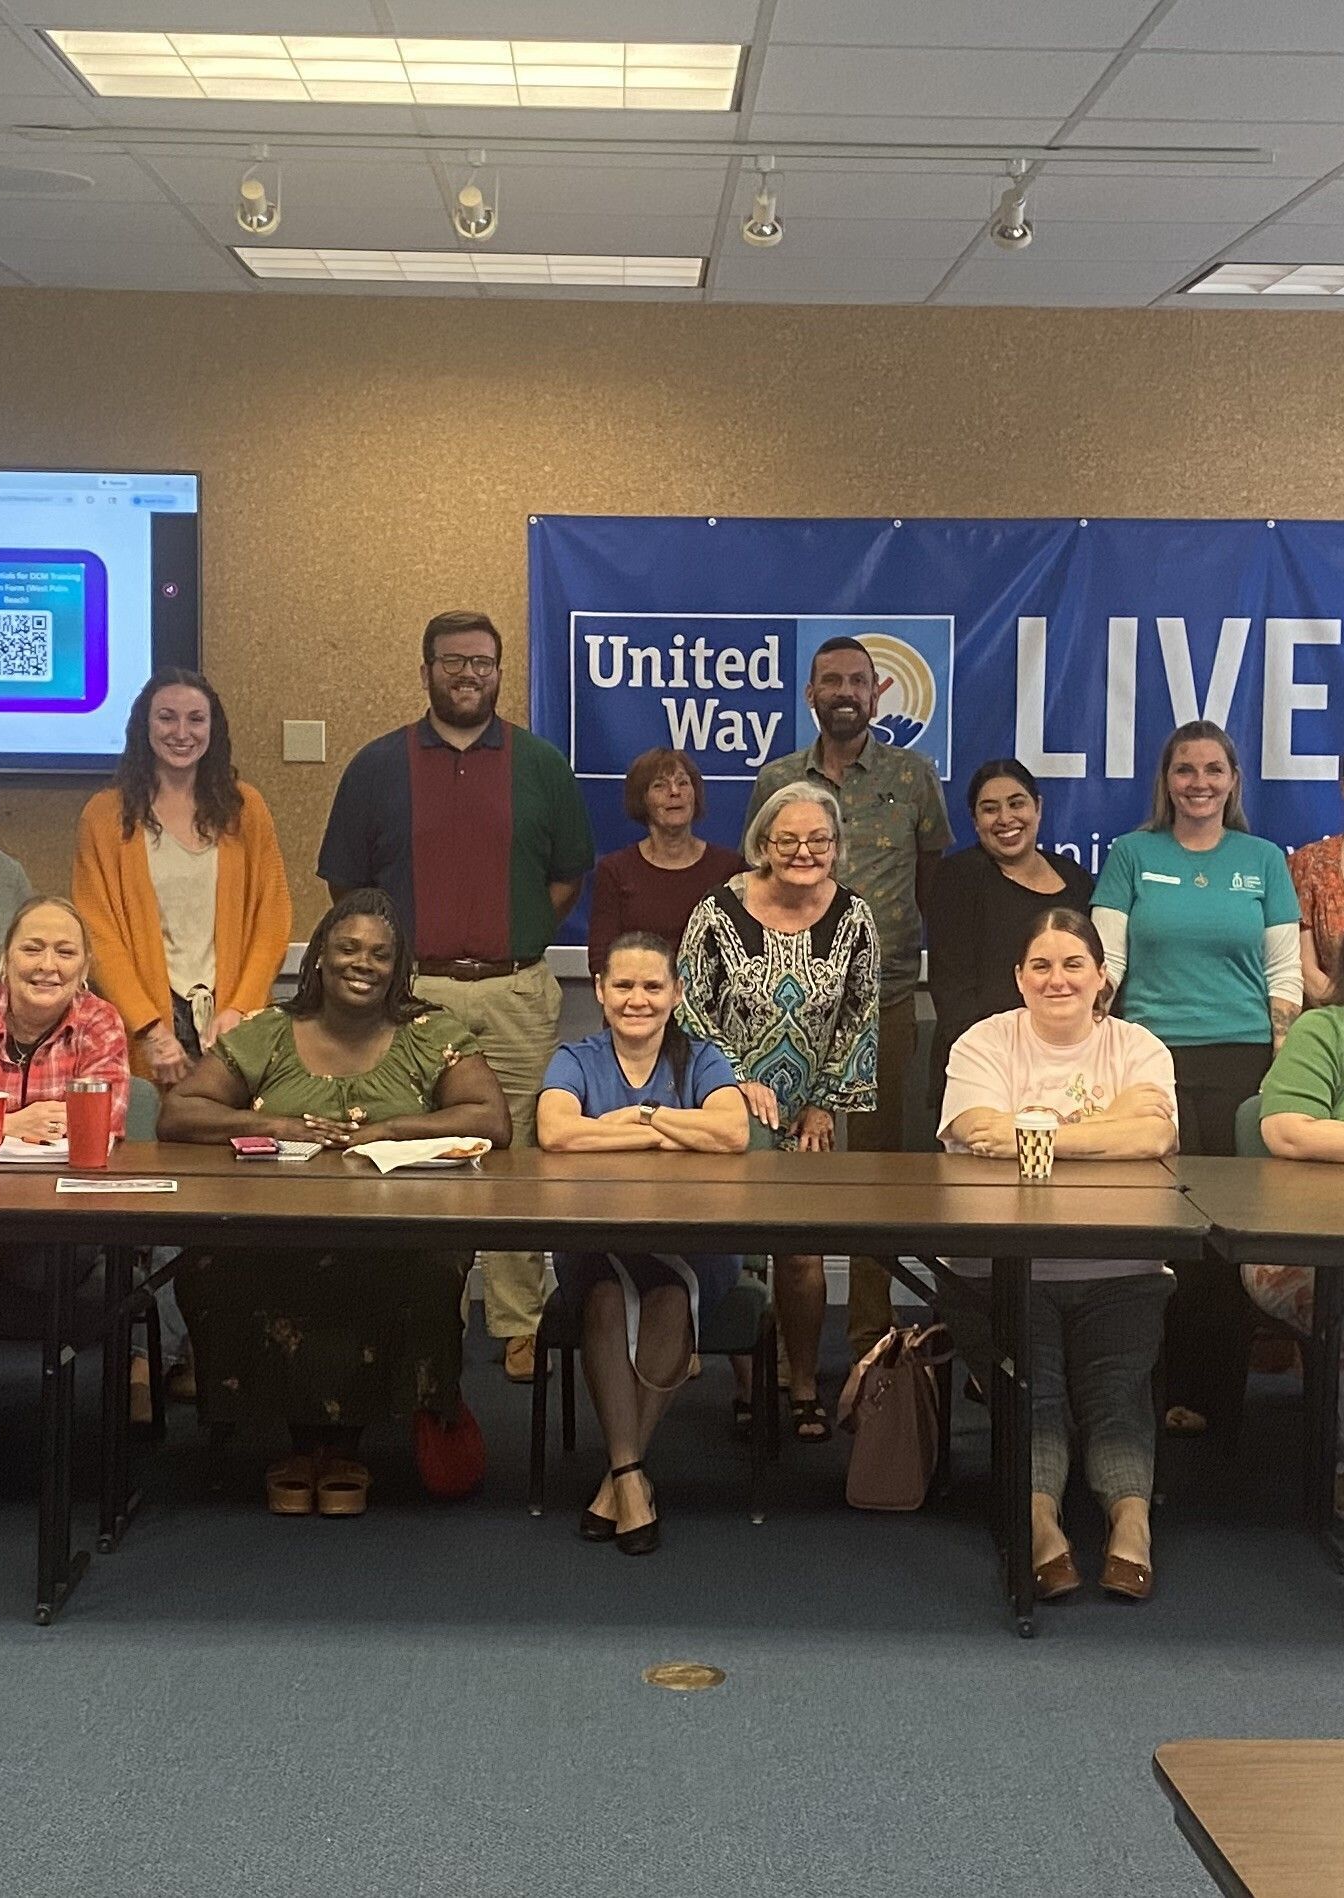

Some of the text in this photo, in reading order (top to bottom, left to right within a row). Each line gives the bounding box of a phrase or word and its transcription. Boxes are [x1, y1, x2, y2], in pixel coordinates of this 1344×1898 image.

[583, 633, 784, 690] United
[661, 697, 783, 767] Way
[1015, 616, 1342, 781] LIVE
